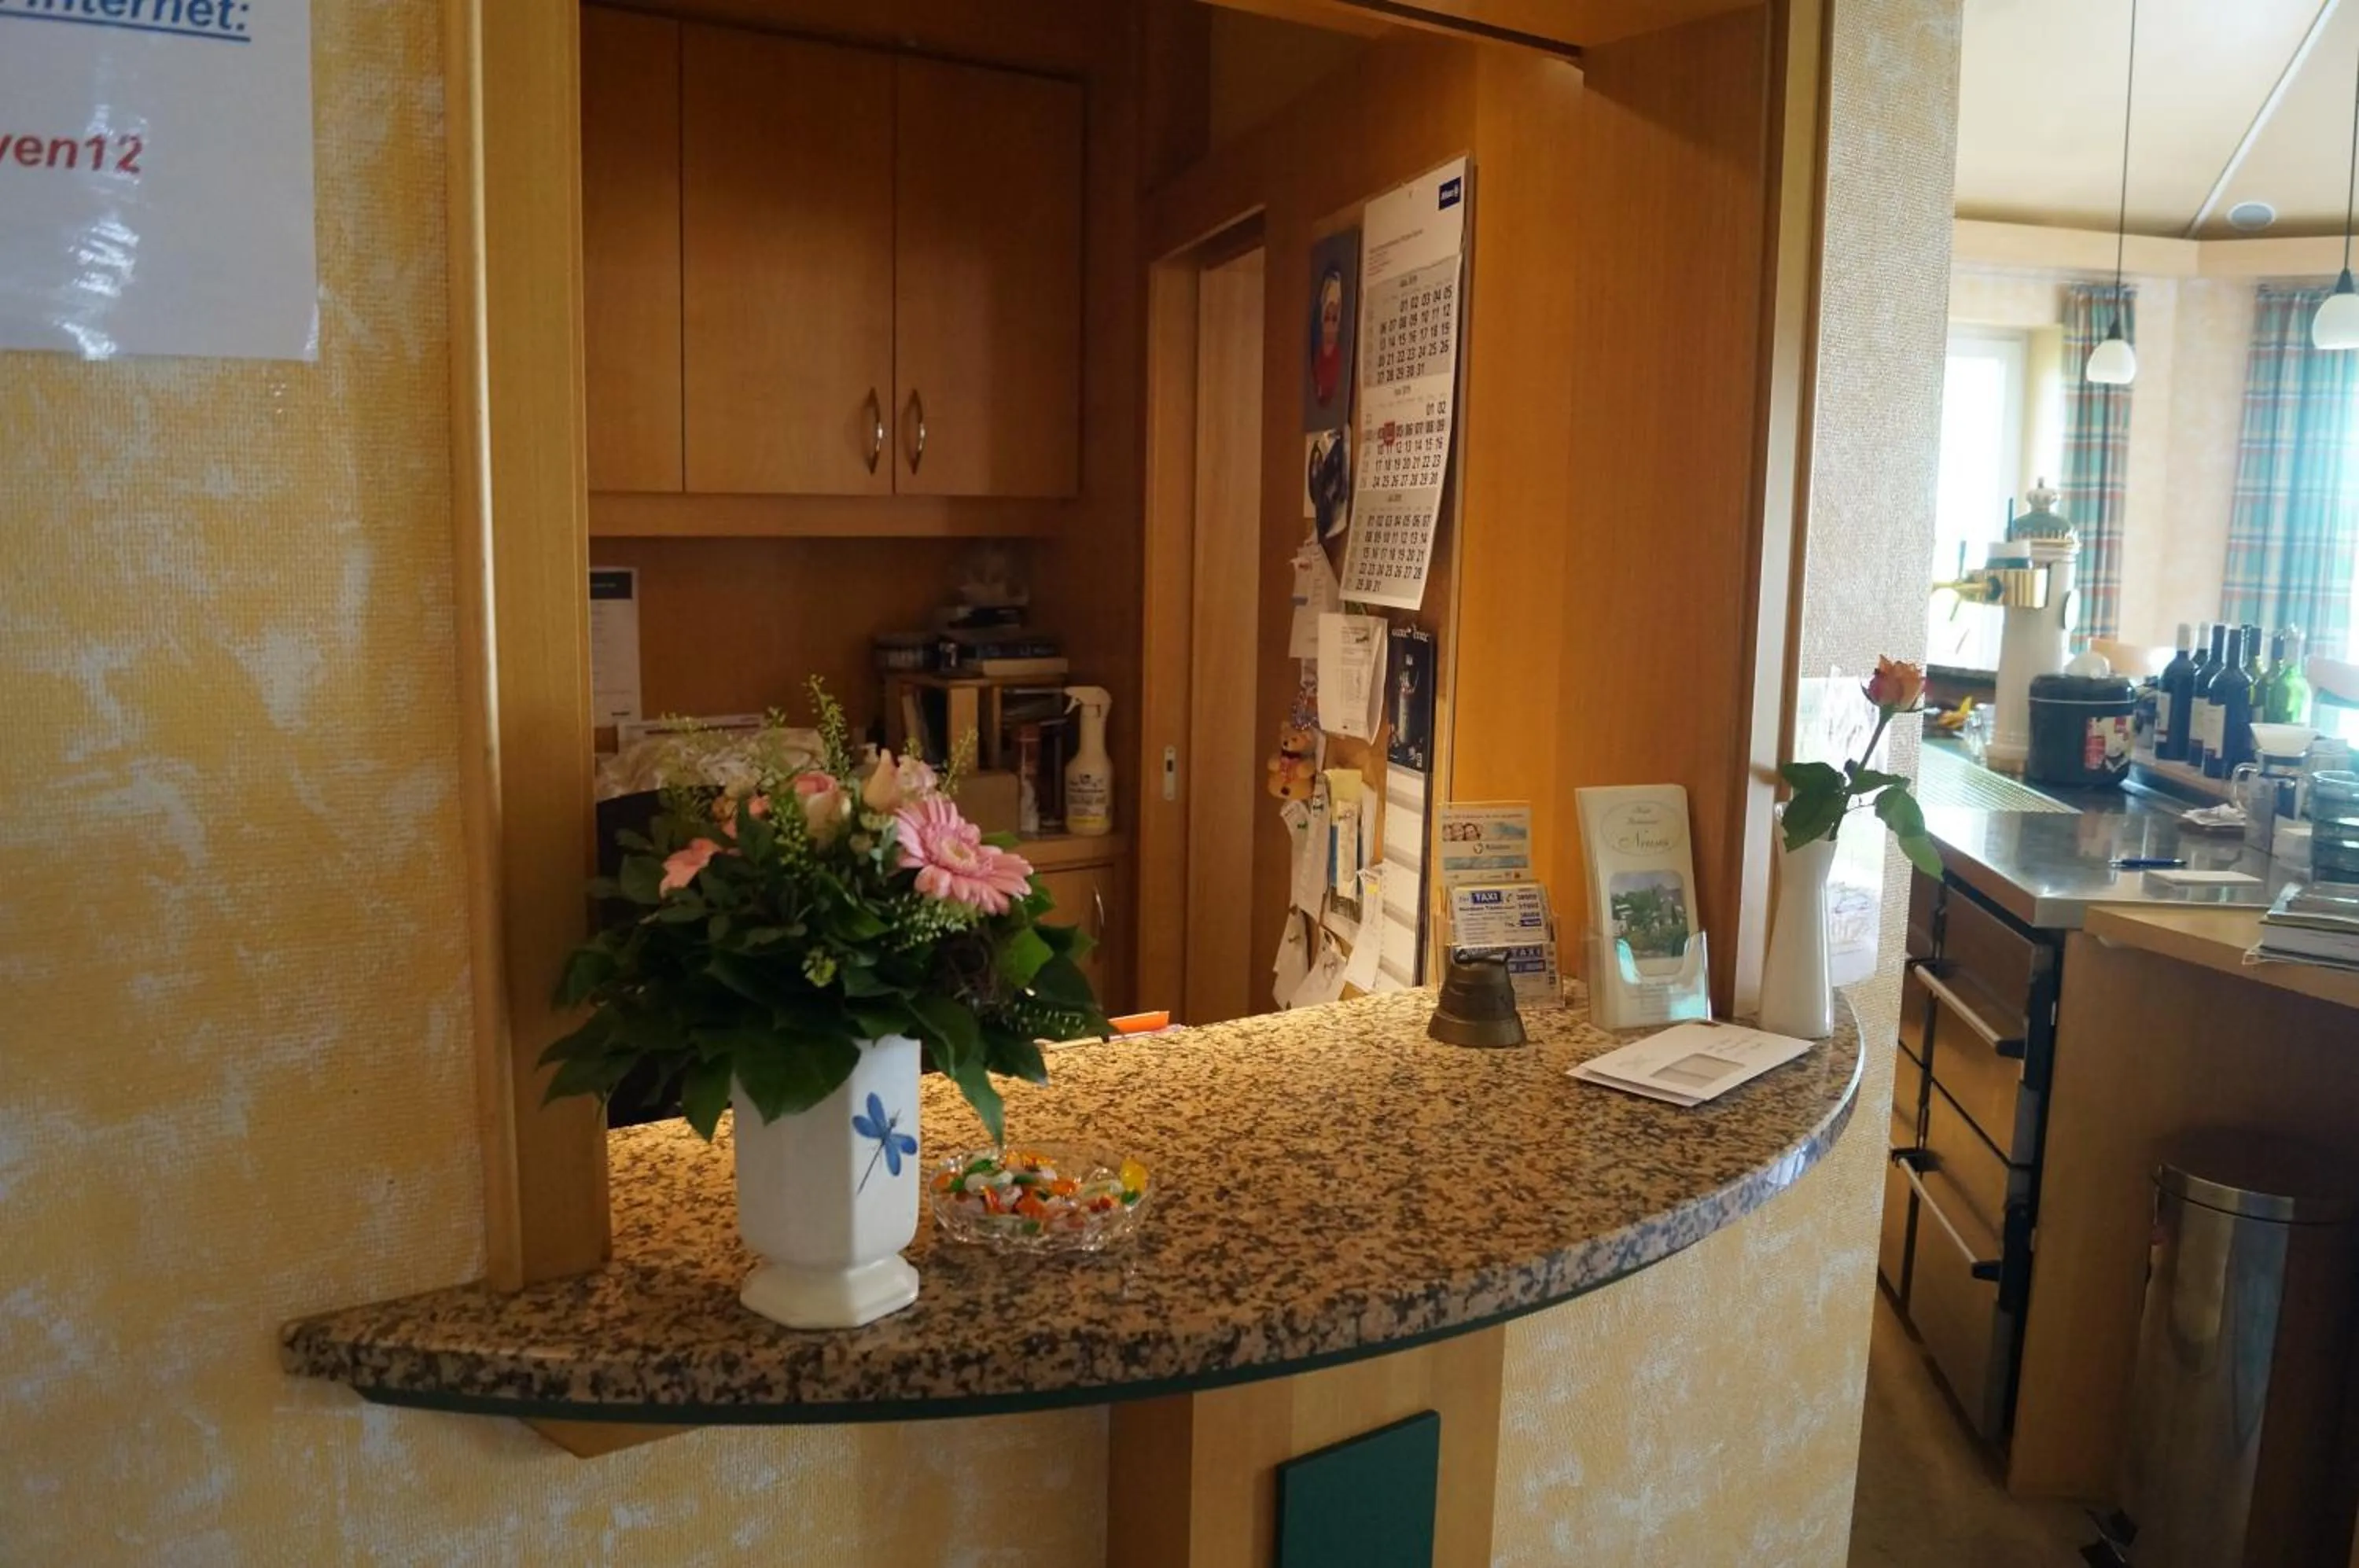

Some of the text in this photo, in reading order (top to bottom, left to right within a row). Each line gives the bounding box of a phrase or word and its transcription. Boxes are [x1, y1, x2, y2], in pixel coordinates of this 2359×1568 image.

[27, 0, 250, 31] ernet:
[1443, 284, 1452, 300] 05
[1474, 893, 1498, 902] TAXI
[1511, 948, 1541, 958] TAXI
